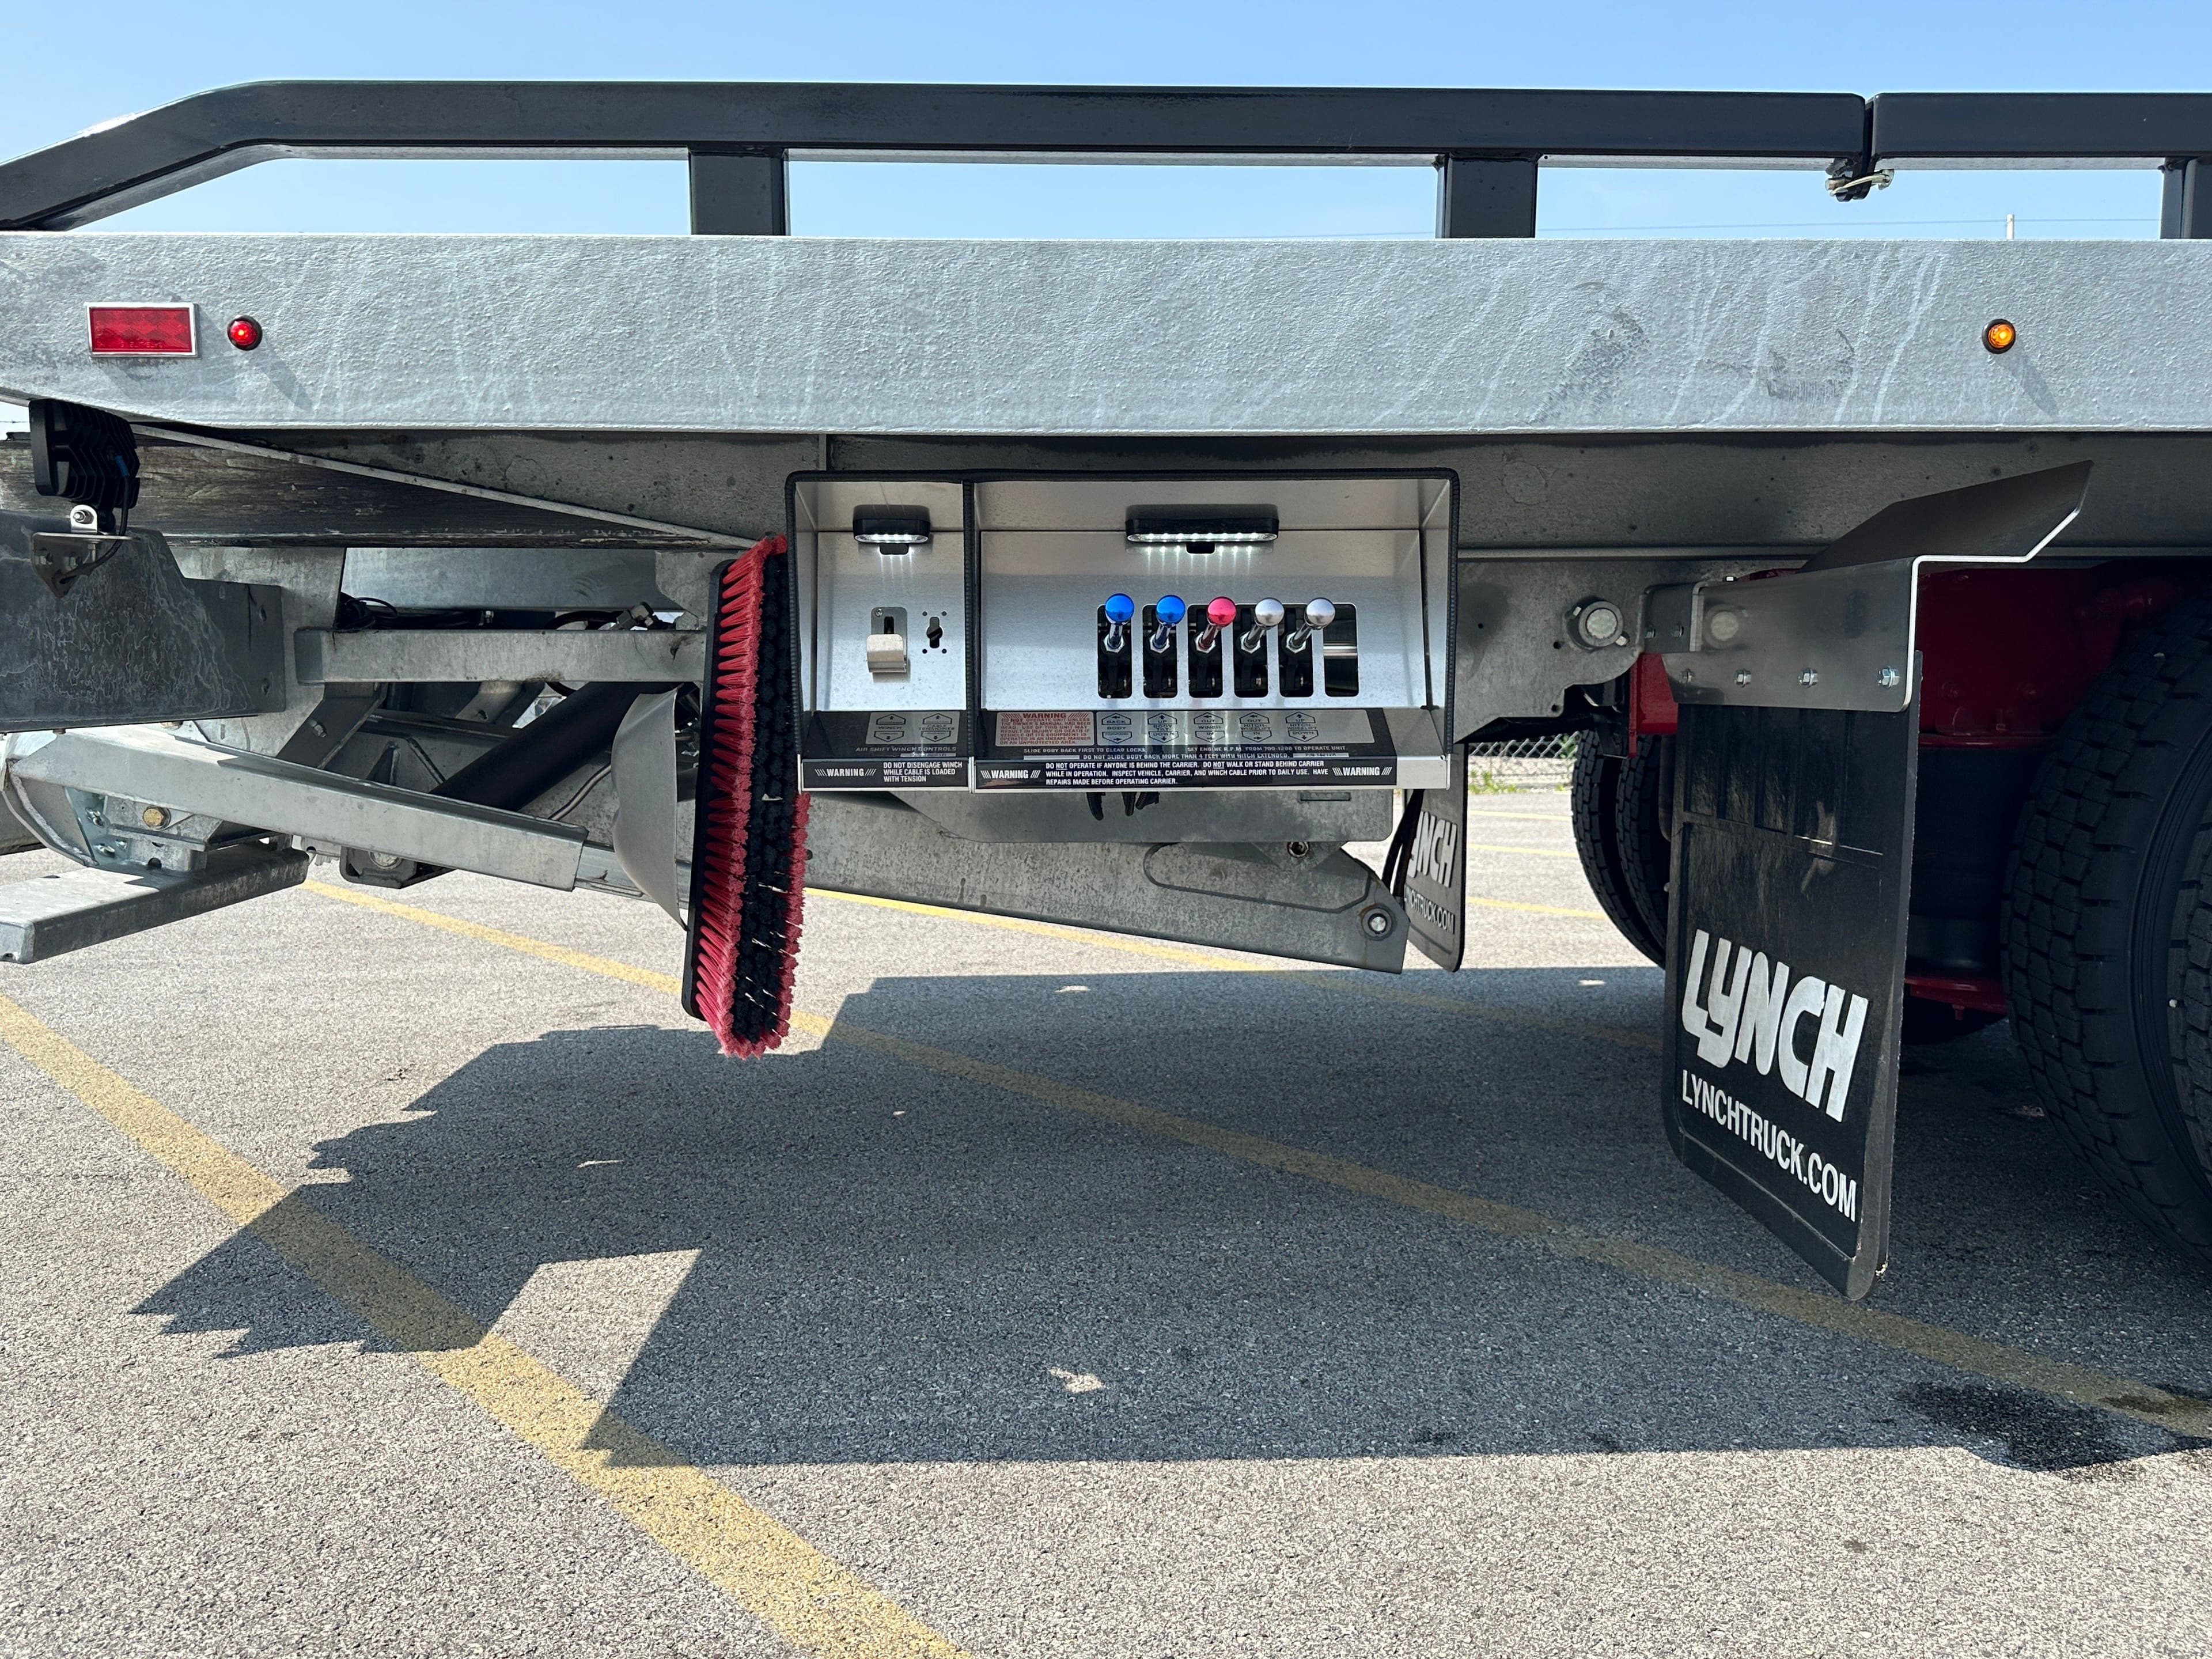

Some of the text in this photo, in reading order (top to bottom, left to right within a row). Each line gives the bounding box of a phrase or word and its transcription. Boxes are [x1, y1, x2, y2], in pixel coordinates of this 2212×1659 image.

[826, 768, 865, 777] WARNING
[990, 770, 1029, 779] WARNING
[1342, 767, 1380, 776] WARNING
[1407, 810, 1457, 888] YNCH
[1681, 929, 1869, 1122] LYNCH
[1682, 1069, 1857, 1222] LYNCHTRUCK.COM
